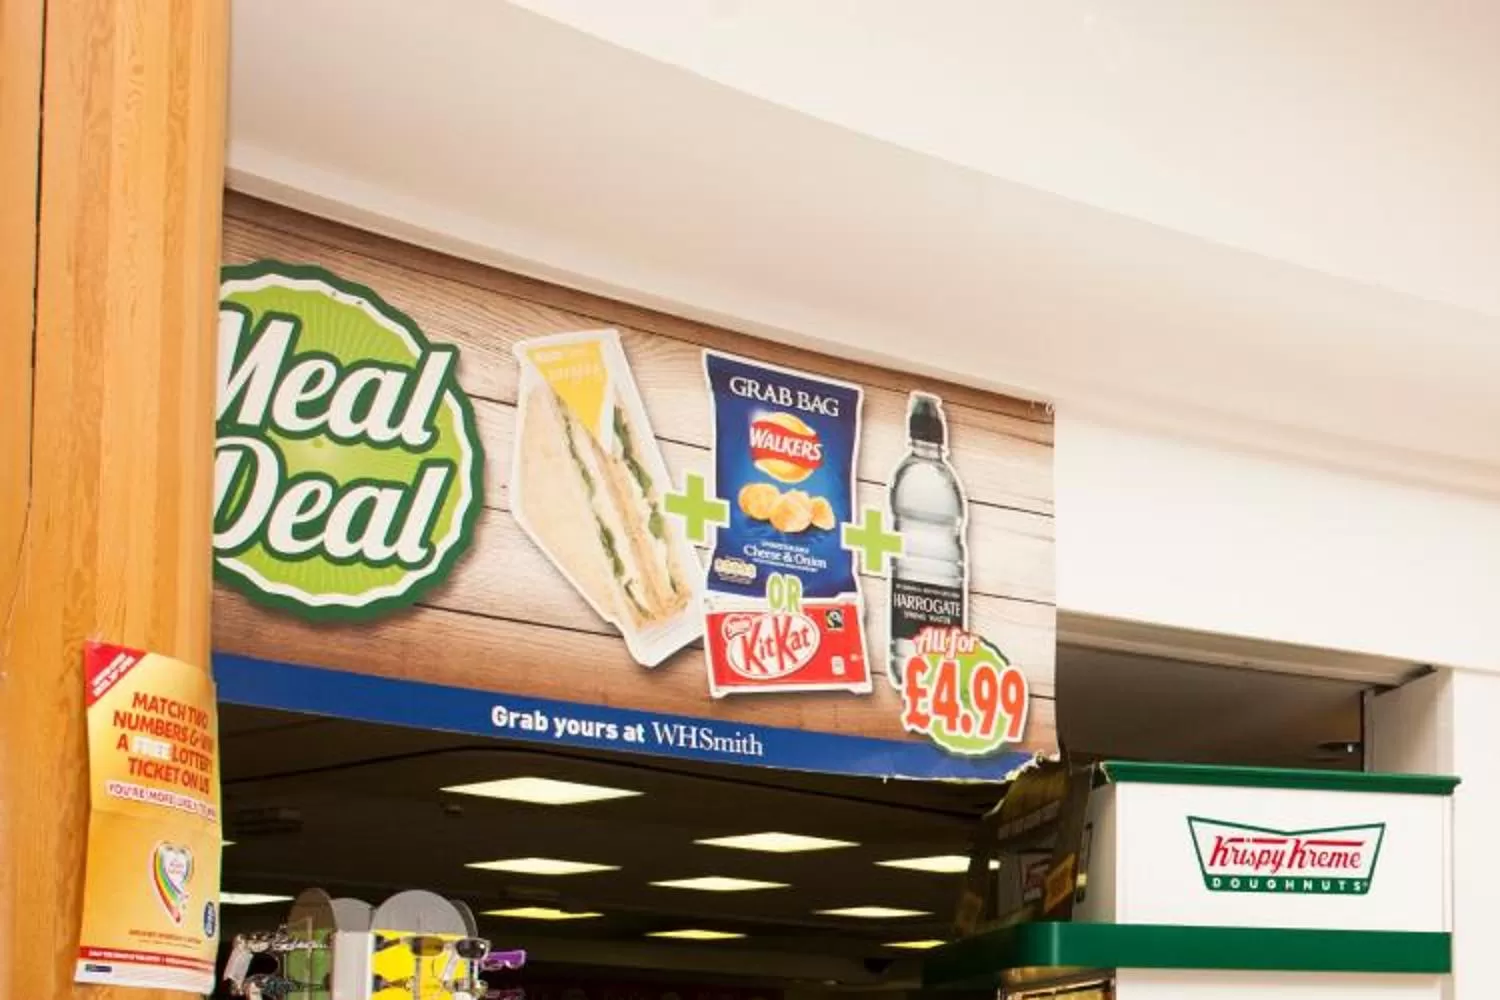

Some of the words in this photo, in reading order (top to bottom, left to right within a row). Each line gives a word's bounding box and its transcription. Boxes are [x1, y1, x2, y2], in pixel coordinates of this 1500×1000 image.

[219, 310, 453, 446] Meal
[729, 376, 793, 407] GRAB
[797, 391, 839, 417] BAG
[750, 426, 824, 462] WALKERS
[214, 442, 453, 563] Deal
[768, 573, 802, 612] OR
[893, 591, 961, 617] HARROGATE
[741, 615, 811, 675] KitKat
[913, 626, 946, 655] All
[945, 628, 978, 658] for
[132, 692, 187, 722] MATCH
[906, 656, 1026, 739] £4.99
[112, 710, 189, 743] NUMBERS
[116, 733, 130, 751] A
[491, 705, 548, 731] Grab
[553, 715, 618, 738] yours
[622, 723, 646, 743] at
[652, 721, 764, 756] WHSmith
[128, 757, 181, 786] TICKET
[1208, 835, 1287, 874] Krispy
[1287, 838, 1366, 869] Kreme
[1212, 877, 1363, 891] DOUGHNUTS
